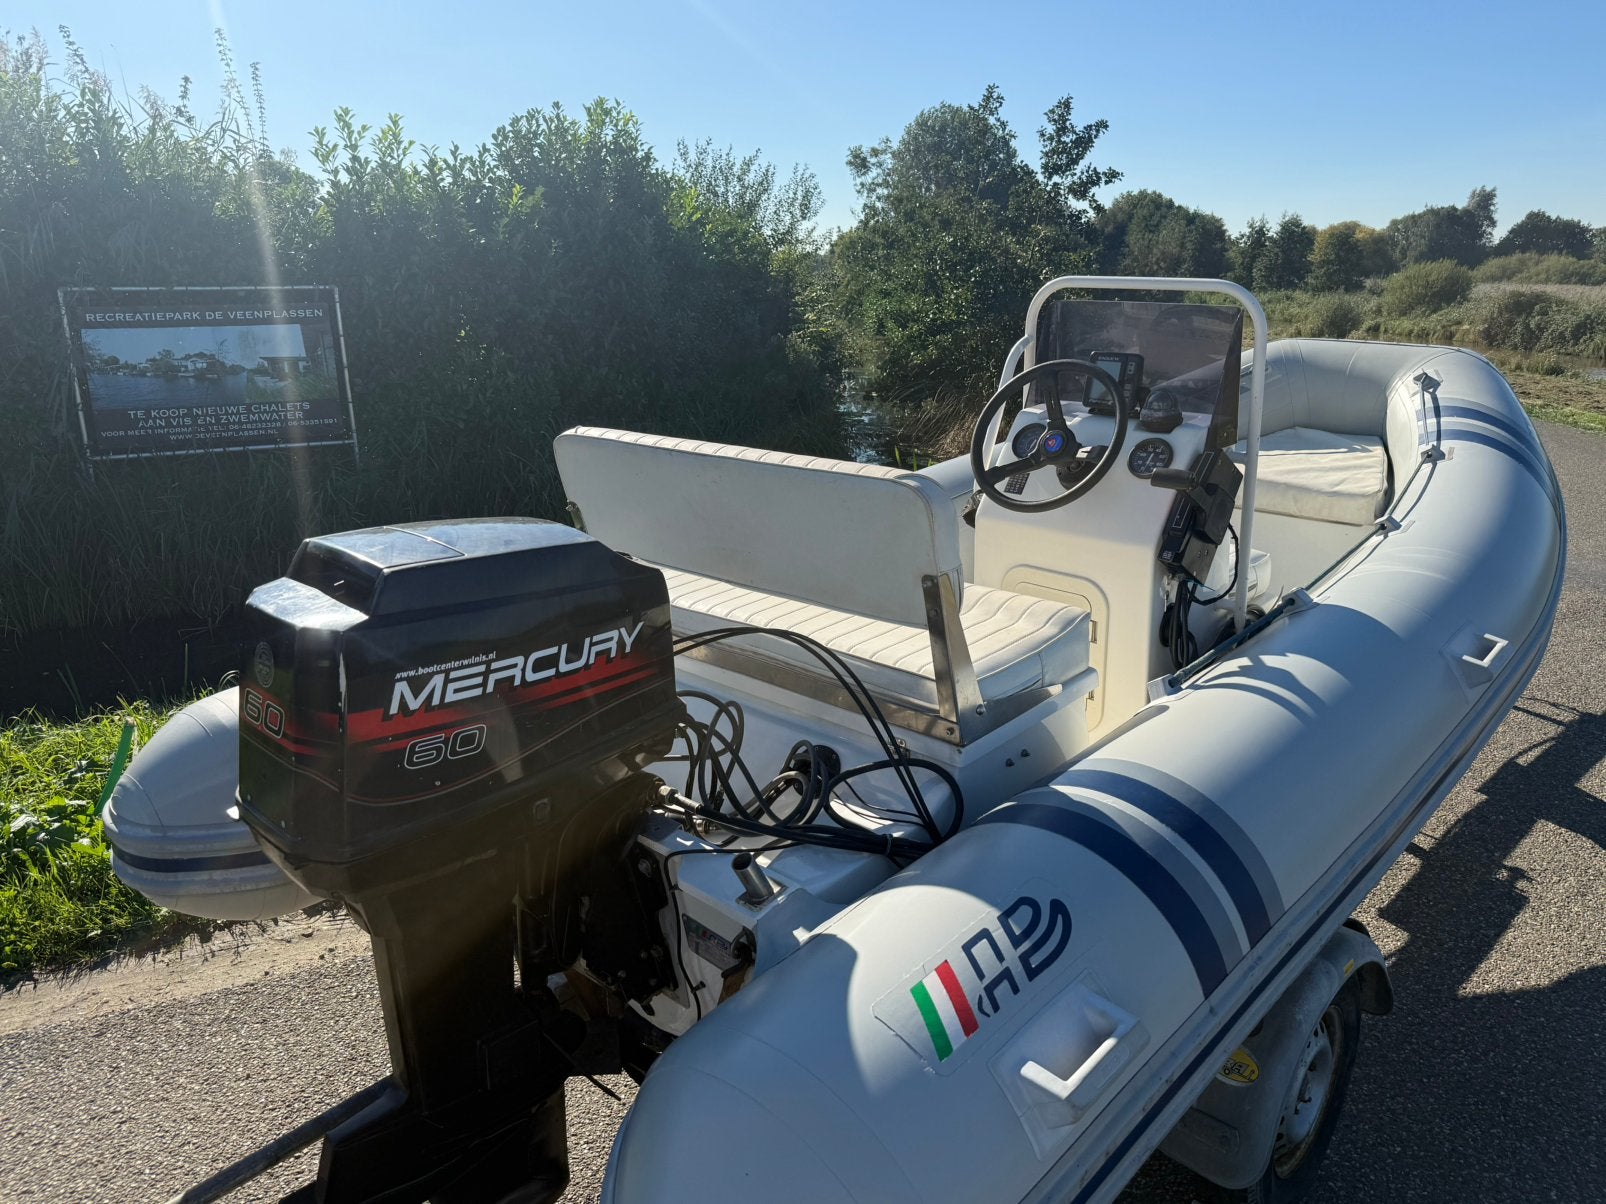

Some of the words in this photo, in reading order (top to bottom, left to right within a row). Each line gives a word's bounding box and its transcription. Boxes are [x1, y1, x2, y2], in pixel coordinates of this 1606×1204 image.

[86, 311, 200, 322] RECREATIEPARK
[206, 310, 223, 320] DE
[228, 308, 323, 319] VEENPLASSEN
[128, 410, 146, 419] TE
[151, 408, 188, 418] KOOP
[193, 405, 247, 416] NIEUWE
[251, 402, 311, 413] CHALETS
[138, 418, 166, 428] AAN
[170, 417, 192, 426] VIS
[197, 415, 216, 425] EN
[220, 411, 304, 424] ZWEMWATER
[389, 621, 645, 716] MERCURY
[244, 687, 286, 739] 60
[404, 723, 487, 770] 60
